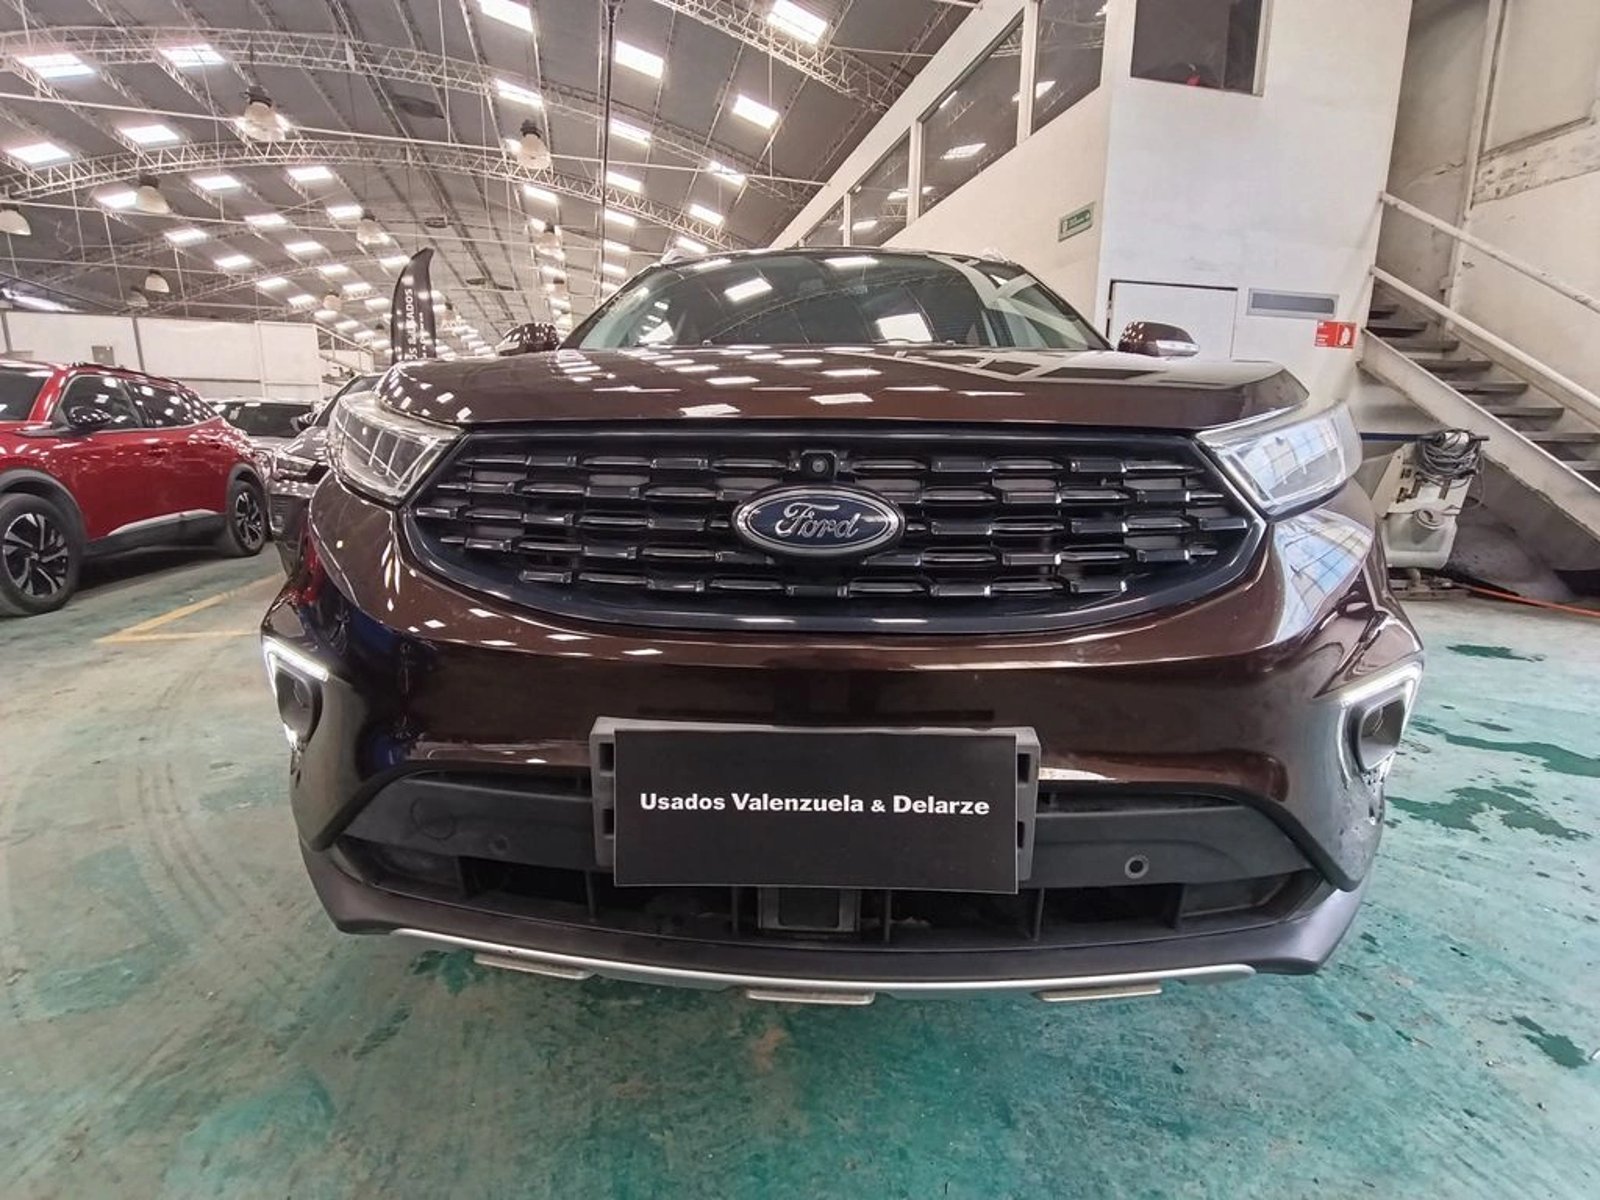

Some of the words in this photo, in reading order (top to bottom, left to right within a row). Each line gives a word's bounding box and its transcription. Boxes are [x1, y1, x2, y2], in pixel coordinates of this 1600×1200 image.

[774, 501, 862, 539] Ford
[640, 792, 726, 811] Usados
[731, 792, 864, 812] Valenzuela
[870, 799, 886, 813] &
[893, 794, 990, 815] Delarze
